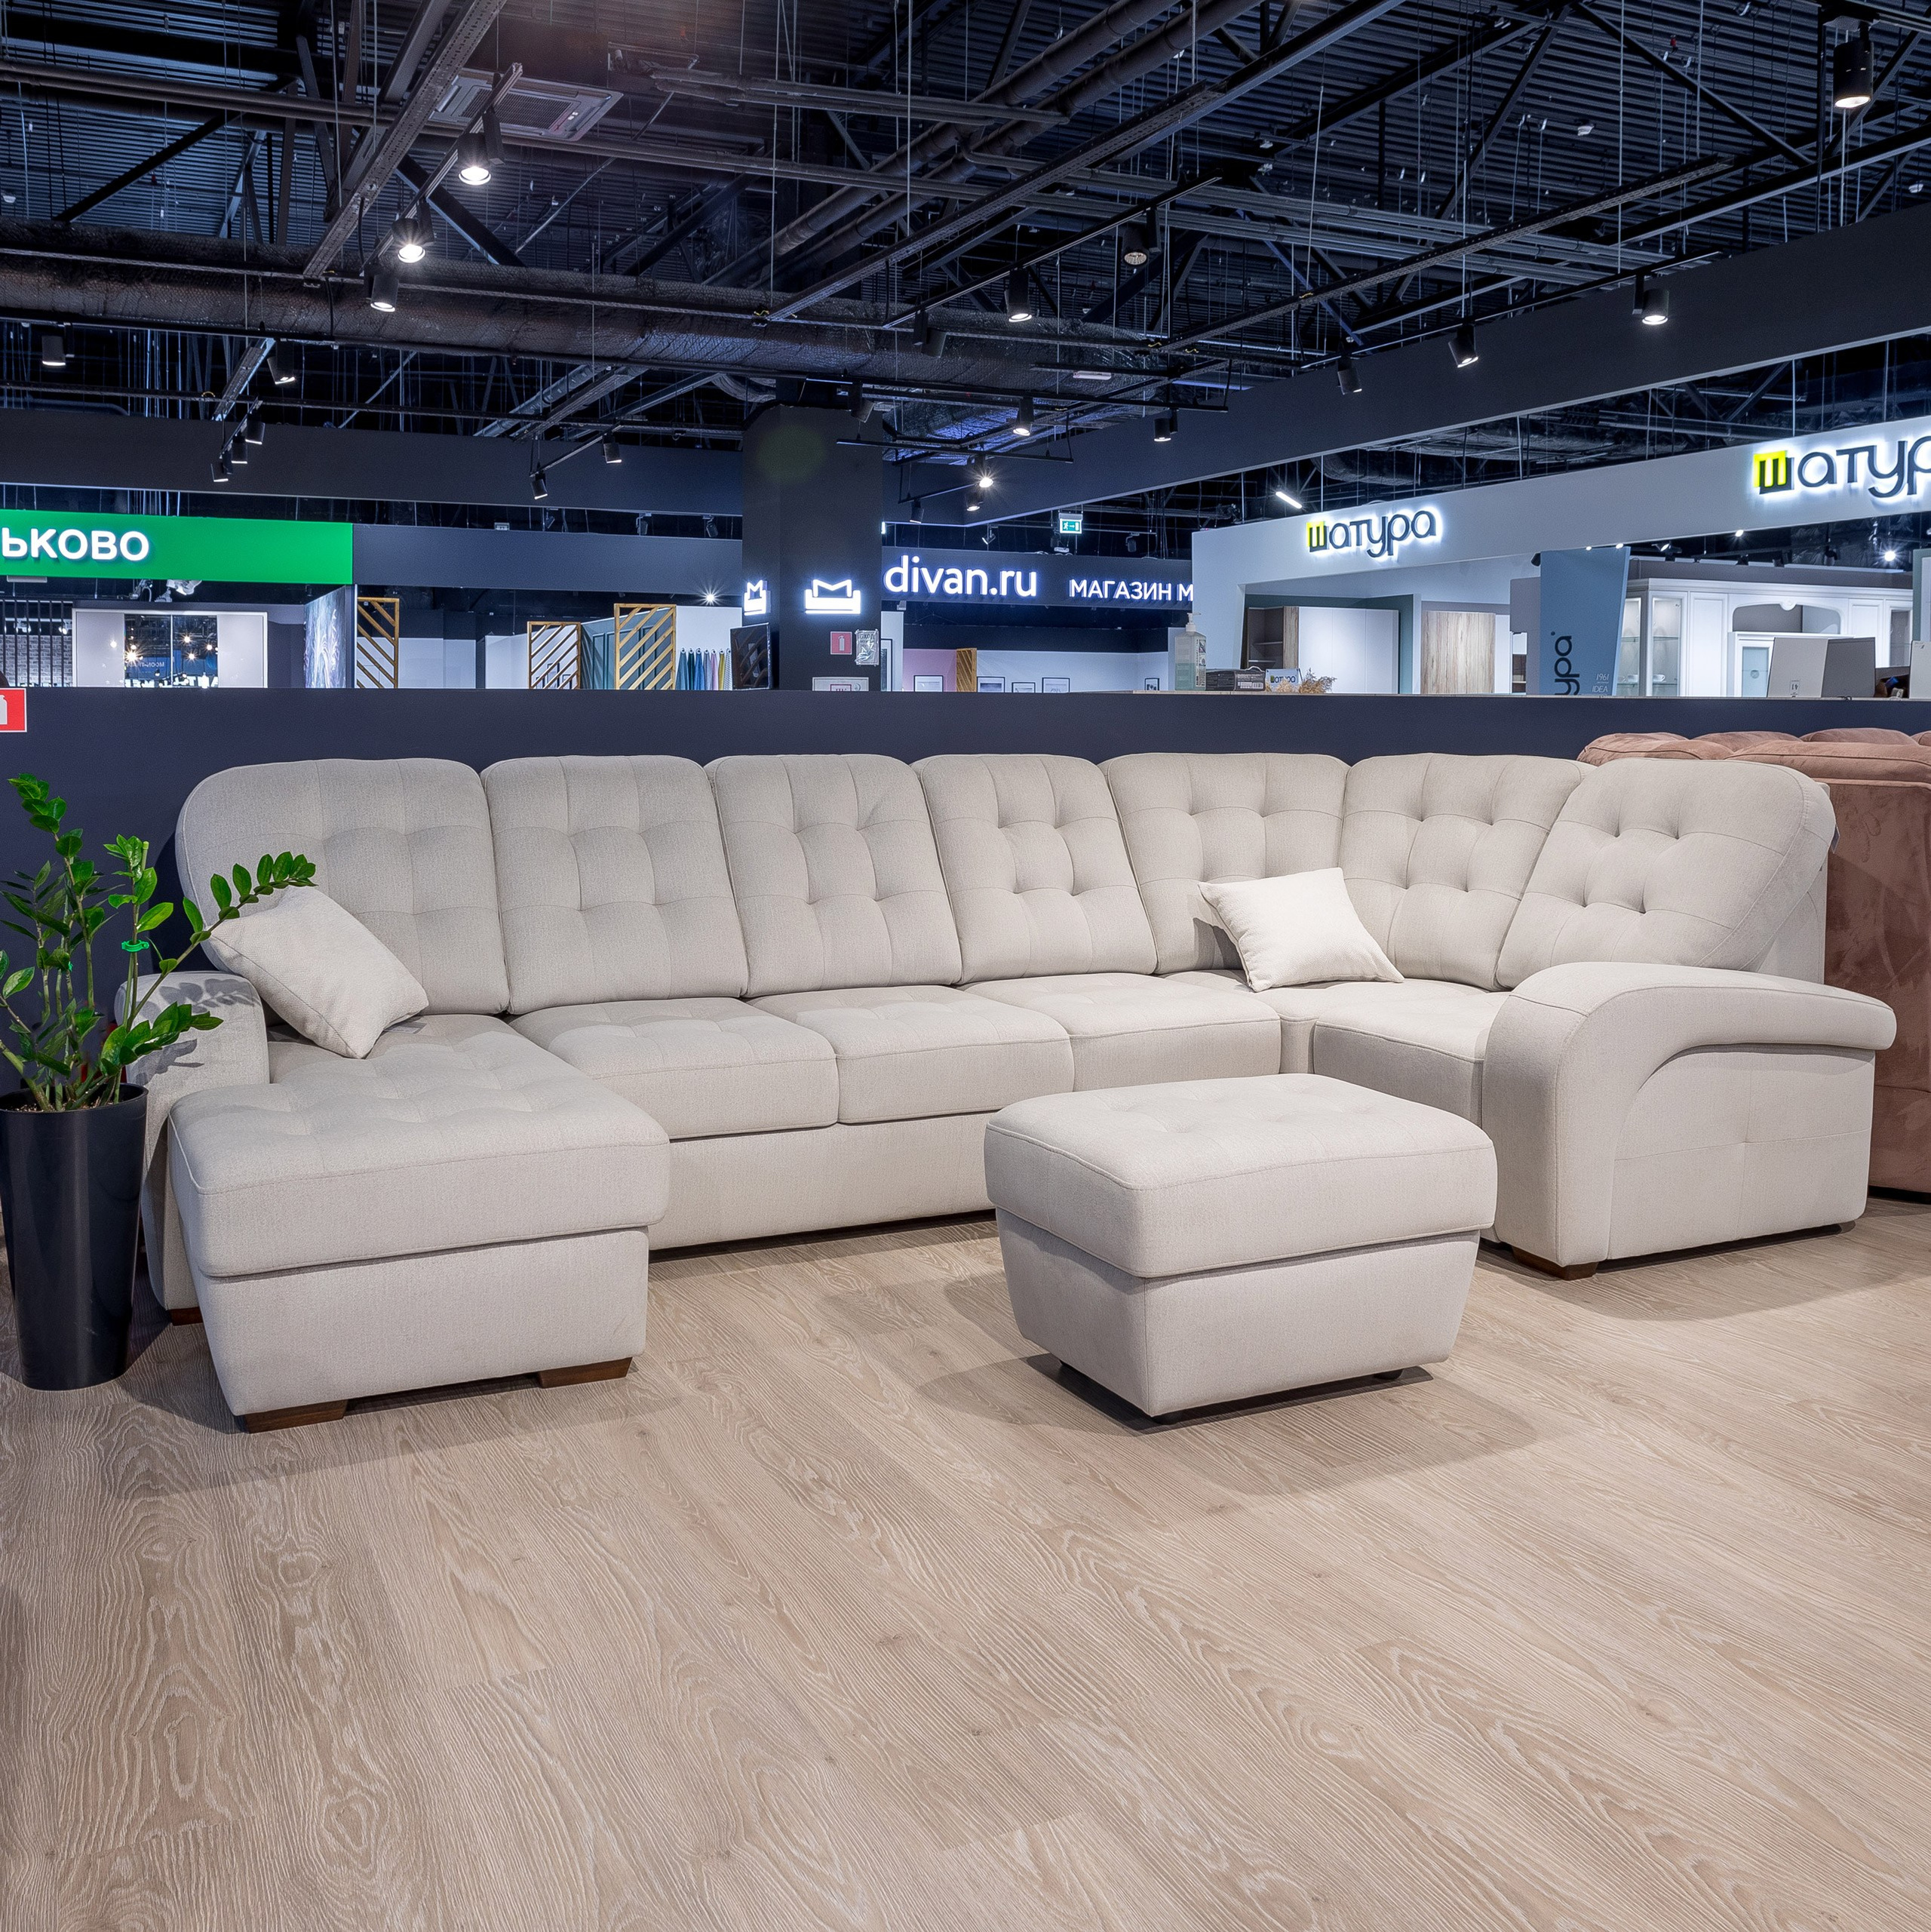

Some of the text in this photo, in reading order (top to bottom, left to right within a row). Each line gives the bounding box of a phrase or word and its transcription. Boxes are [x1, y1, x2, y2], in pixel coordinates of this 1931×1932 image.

[2, 527, 149, 561] ЬКОВО
[883, 554, 1037, 597] divan.ru
[1069, 579, 1172, 601] МАГАЗИН
